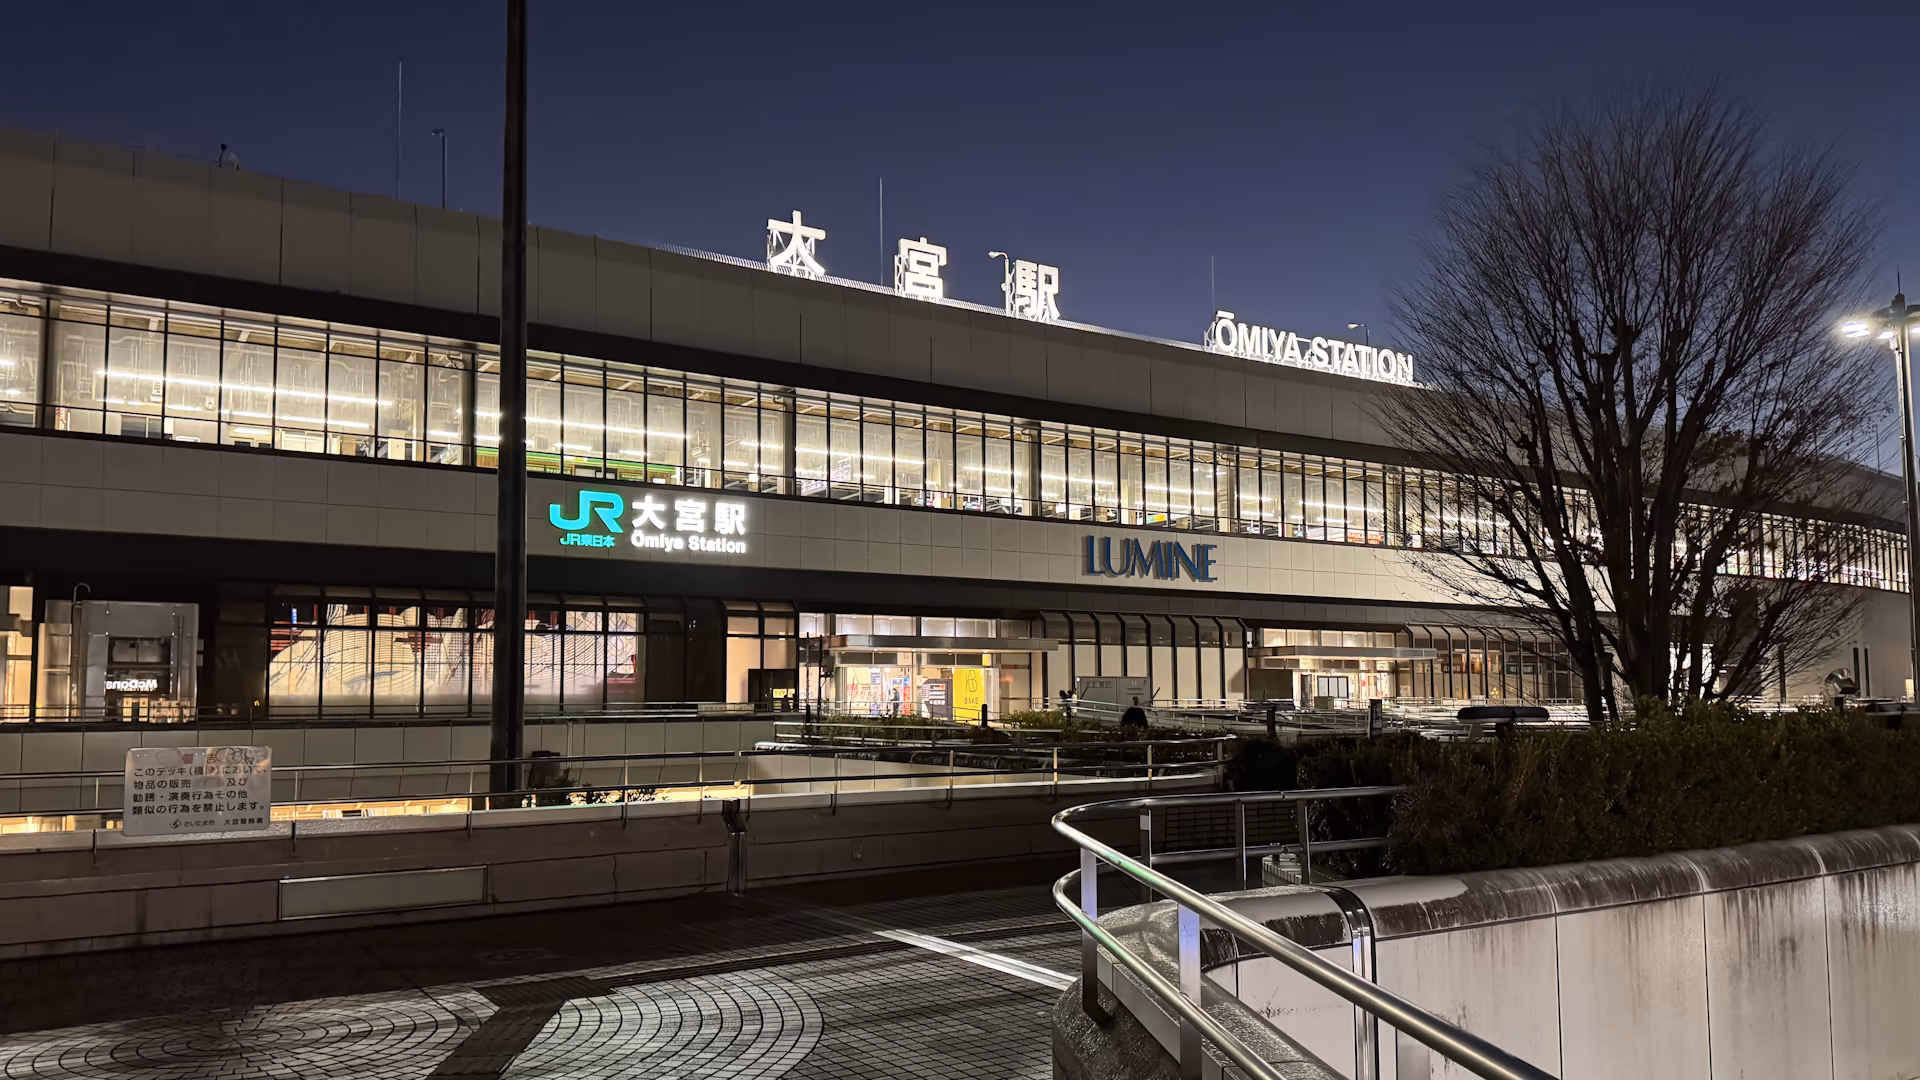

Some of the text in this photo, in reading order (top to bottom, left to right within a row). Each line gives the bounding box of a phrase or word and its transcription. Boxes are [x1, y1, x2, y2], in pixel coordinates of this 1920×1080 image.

[767, 210, 1060, 321] 大宮駅
[1215, 310, 1414, 382] ŌMIYA STATION
[549, 490, 624, 533] JR
[631, 495, 746, 535] 大宮駅
[560, 533, 615, 548] JR東日本
[630, 530, 746, 554] Ōmiya Station
[1086, 535, 1218, 582] LUMINE
[965, 697, 979, 705] BAKE
[132, 801, 265, 816] 類似の行為を禁止します。
